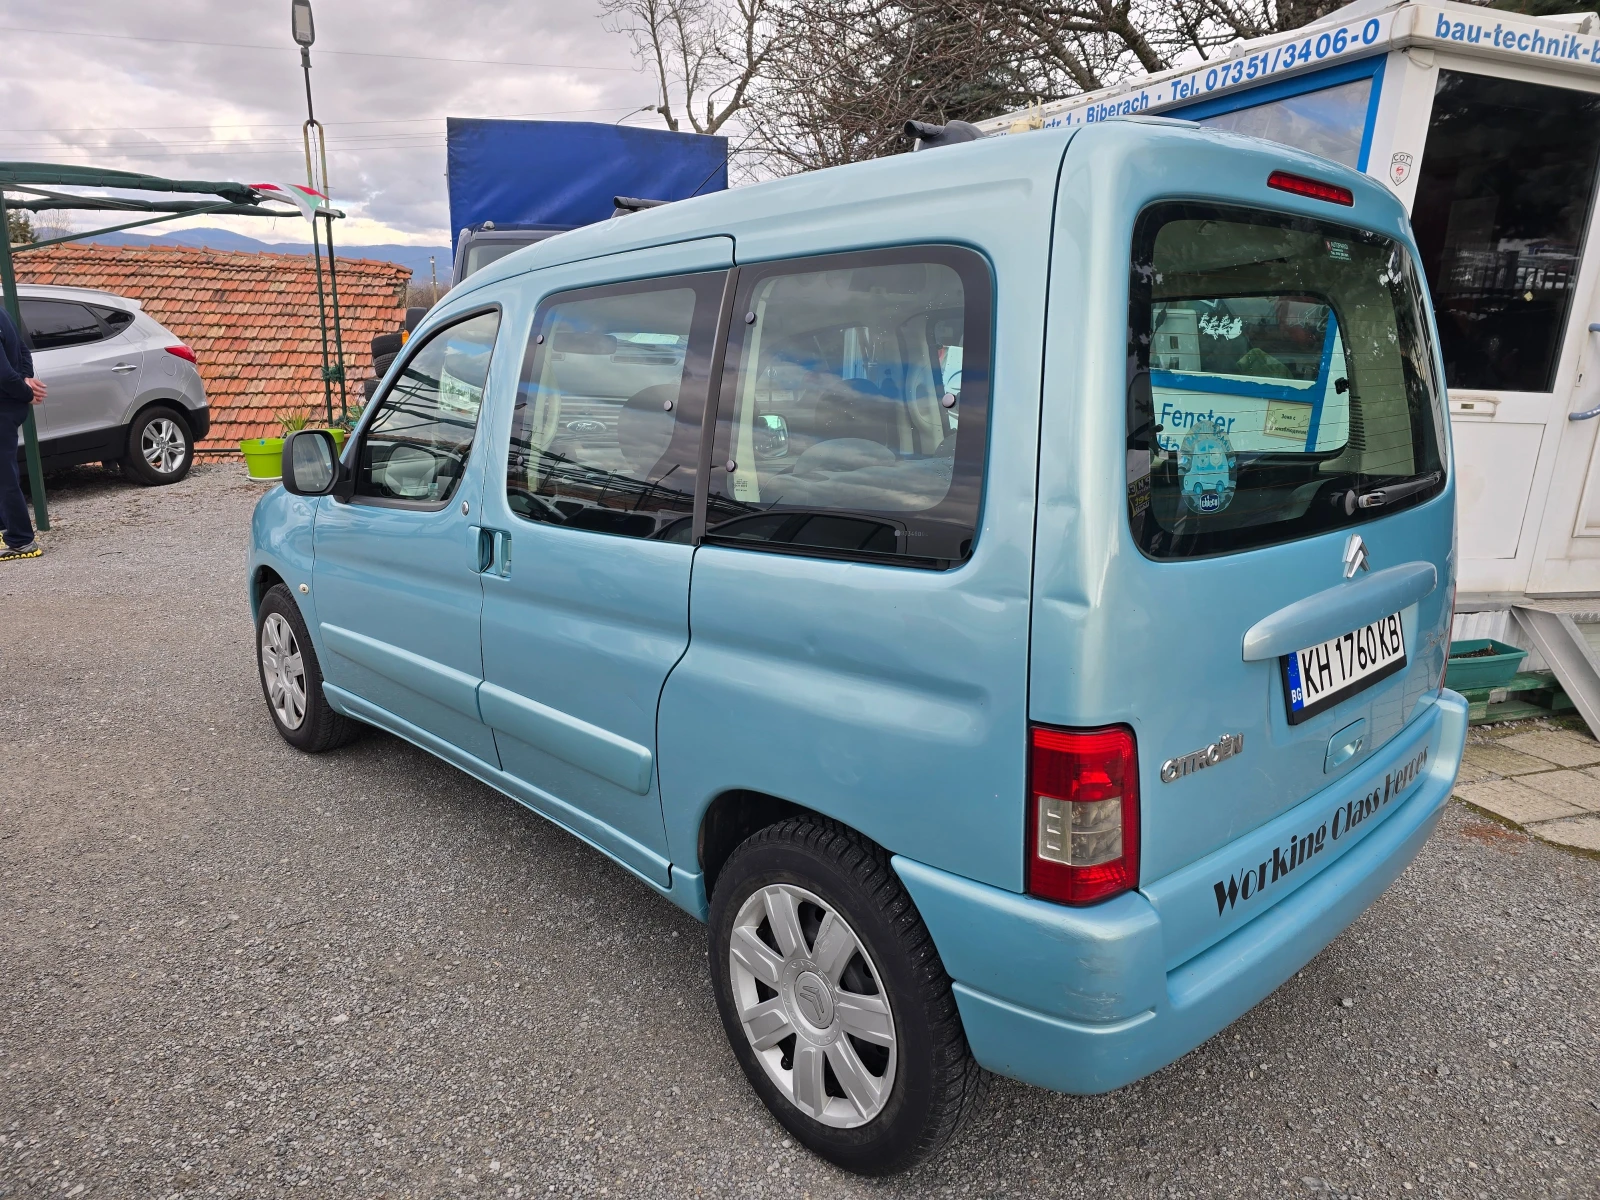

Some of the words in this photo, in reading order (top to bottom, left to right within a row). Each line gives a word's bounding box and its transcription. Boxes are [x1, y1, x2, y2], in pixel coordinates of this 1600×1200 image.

[1086, 91, 1149, 123] Biberach
[1170, 76, 1200, 100] Tel.
[1205, 18, 1380, 91] 07351/3406-0
[1291, 687, 1303, 704] BG
[1301, 643, 1333, 699] KH
[1335, 624, 1377, 681] 1760
[1377, 615, 1401, 660] KB
[1160, 731, 1244, 784] CITROËN
[1213, 821, 1327, 918] Working
[1331, 787, 1381, 841] Class
